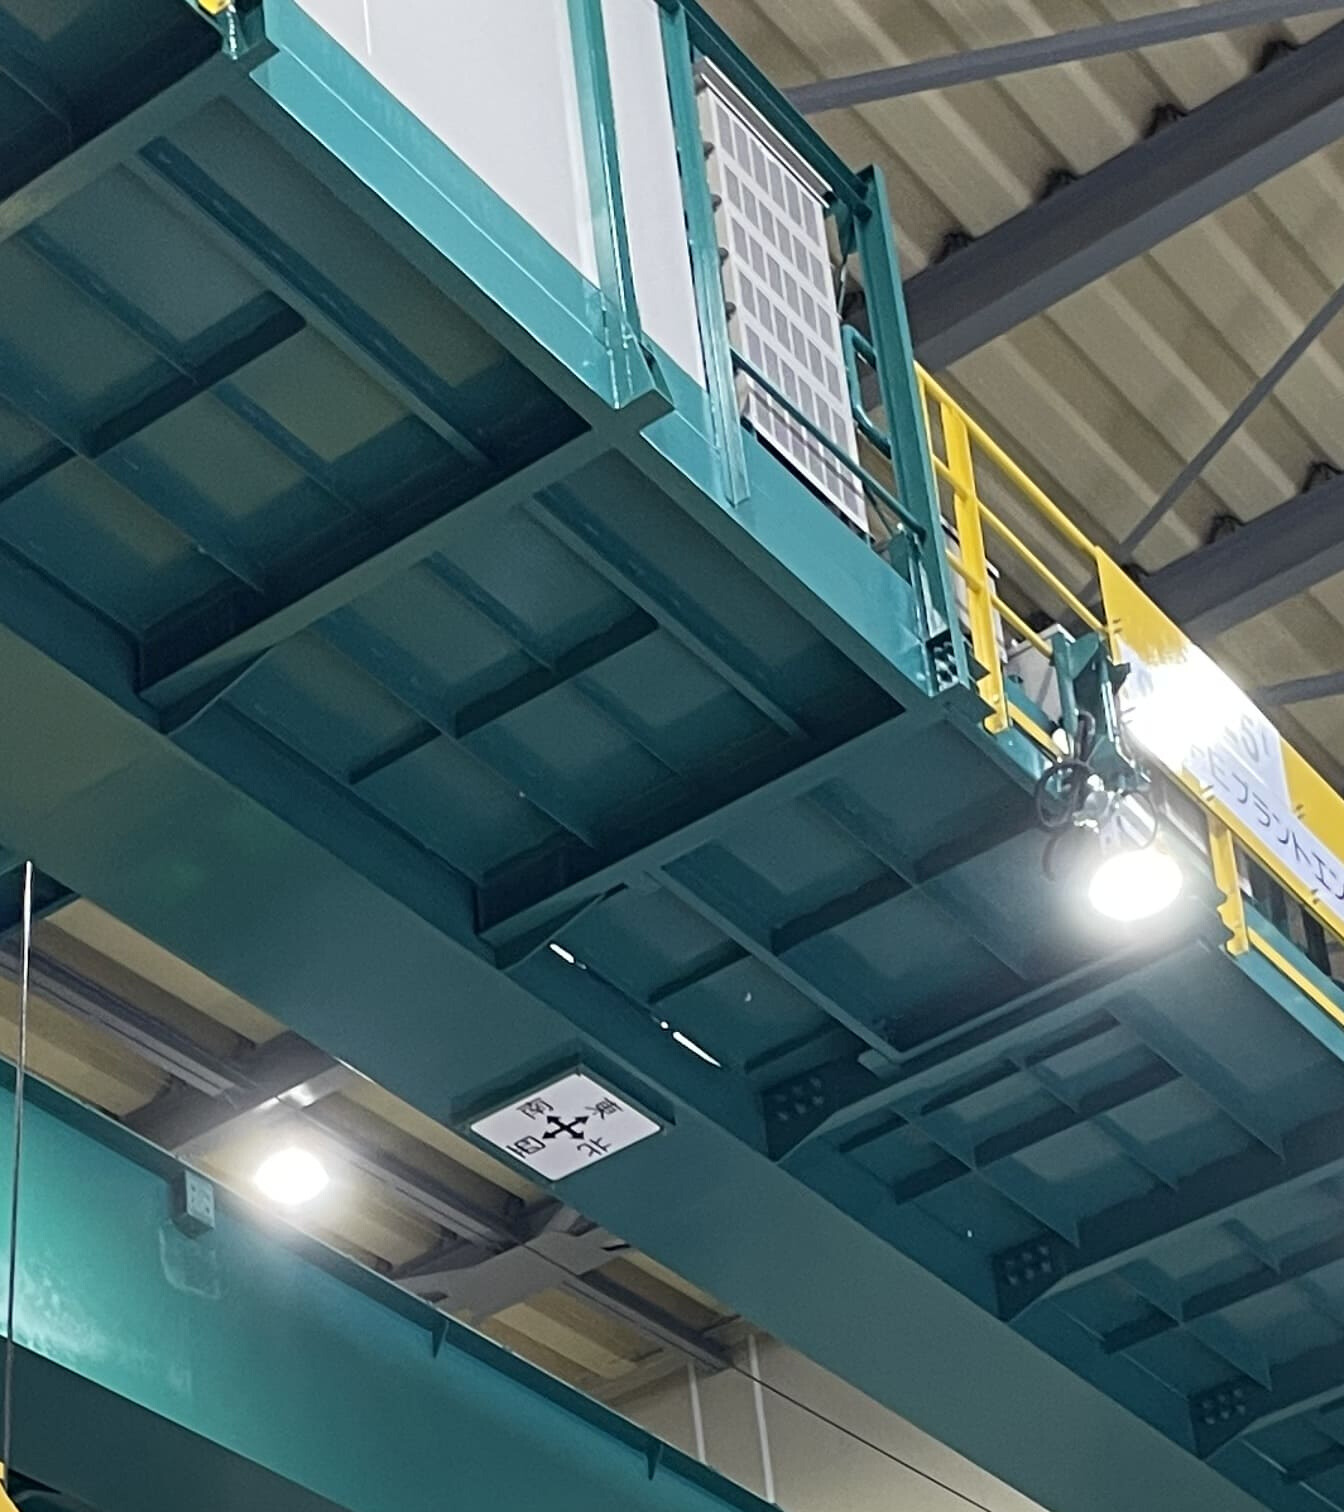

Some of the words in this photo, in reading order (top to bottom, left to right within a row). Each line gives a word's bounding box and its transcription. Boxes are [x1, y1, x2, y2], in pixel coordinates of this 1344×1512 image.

[516, 1097, 554, 1120] 南
[585, 1097, 624, 1120] 東
[506, 1136, 546, 1158] 西
[577, 1137, 612, 1157] 北
